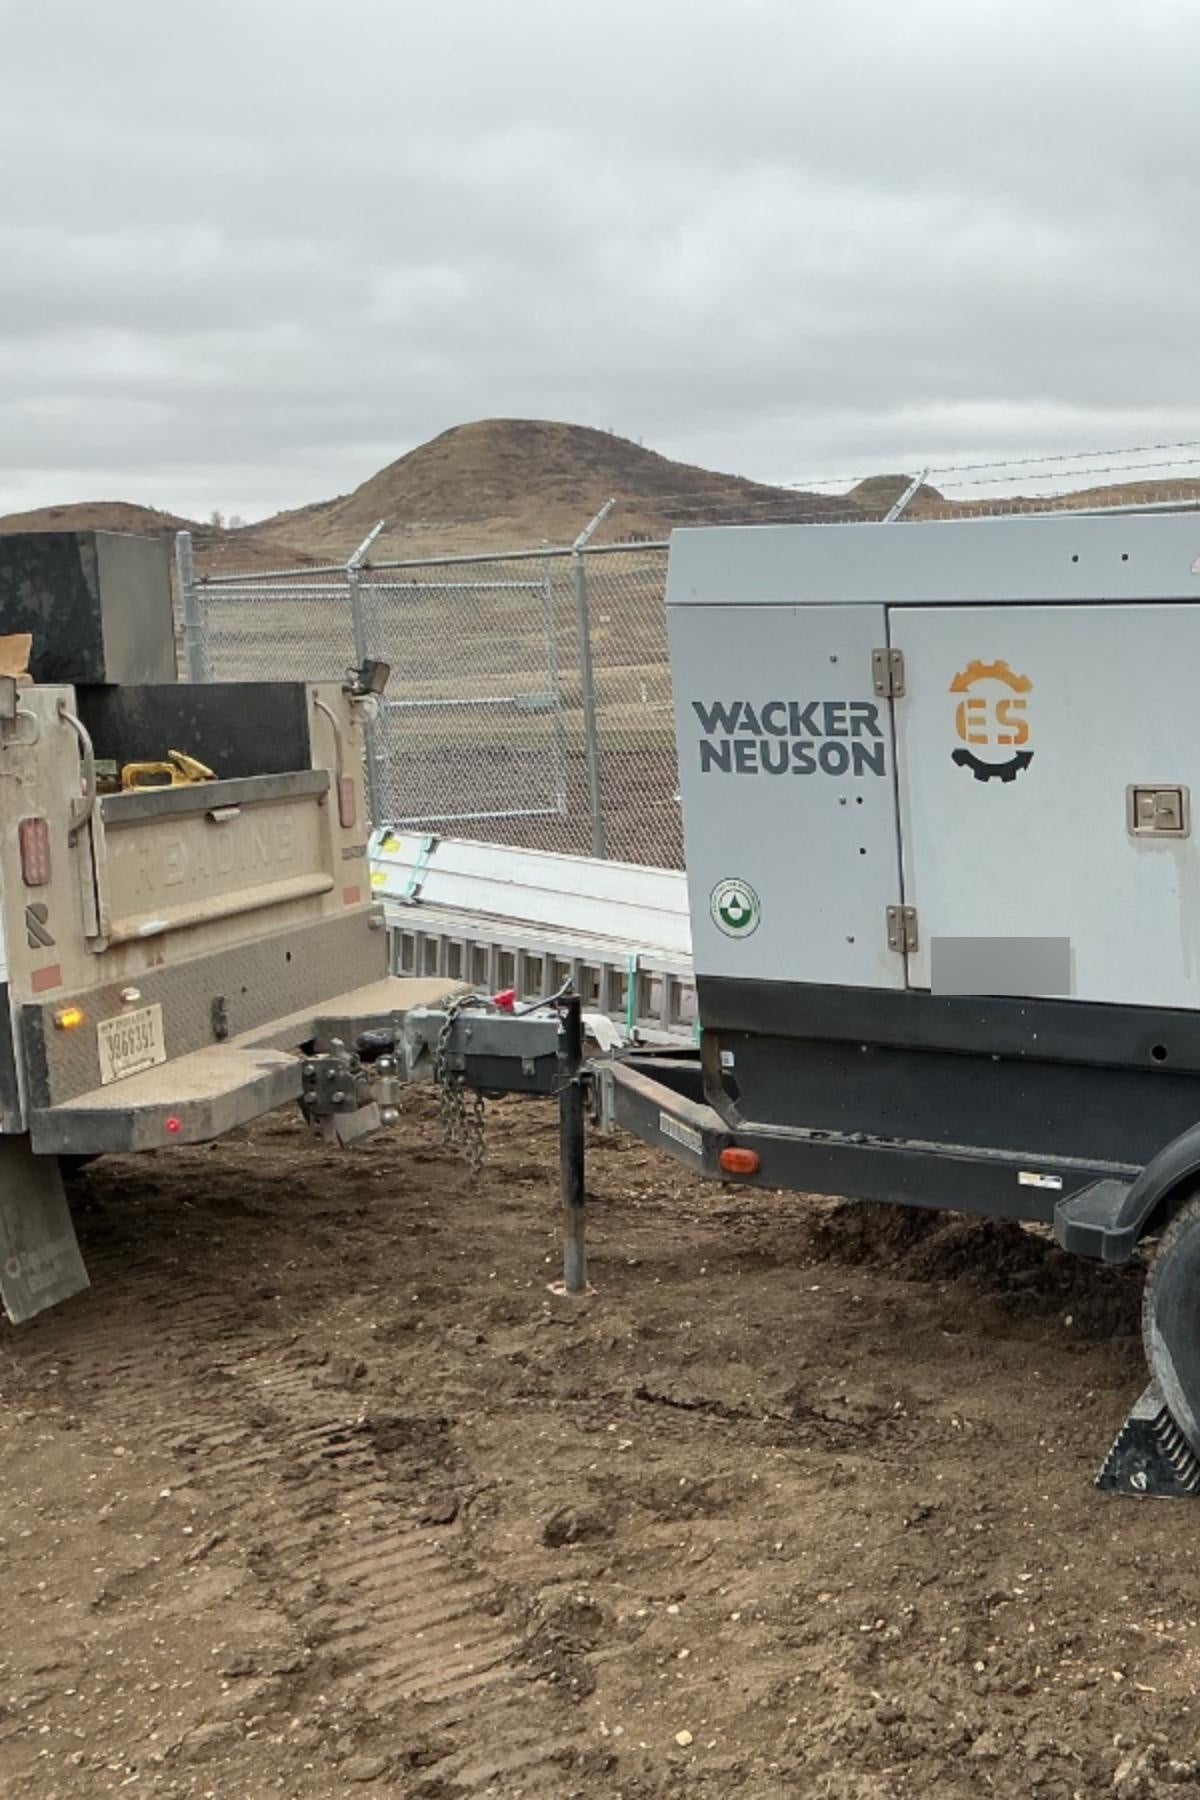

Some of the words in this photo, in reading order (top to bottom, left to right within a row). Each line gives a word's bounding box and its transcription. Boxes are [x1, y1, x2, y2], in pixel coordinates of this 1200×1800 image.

[692, 701, 884, 736] WACKER
[955, 698, 1029, 745] ES
[700, 739, 887, 776] NEUSON
